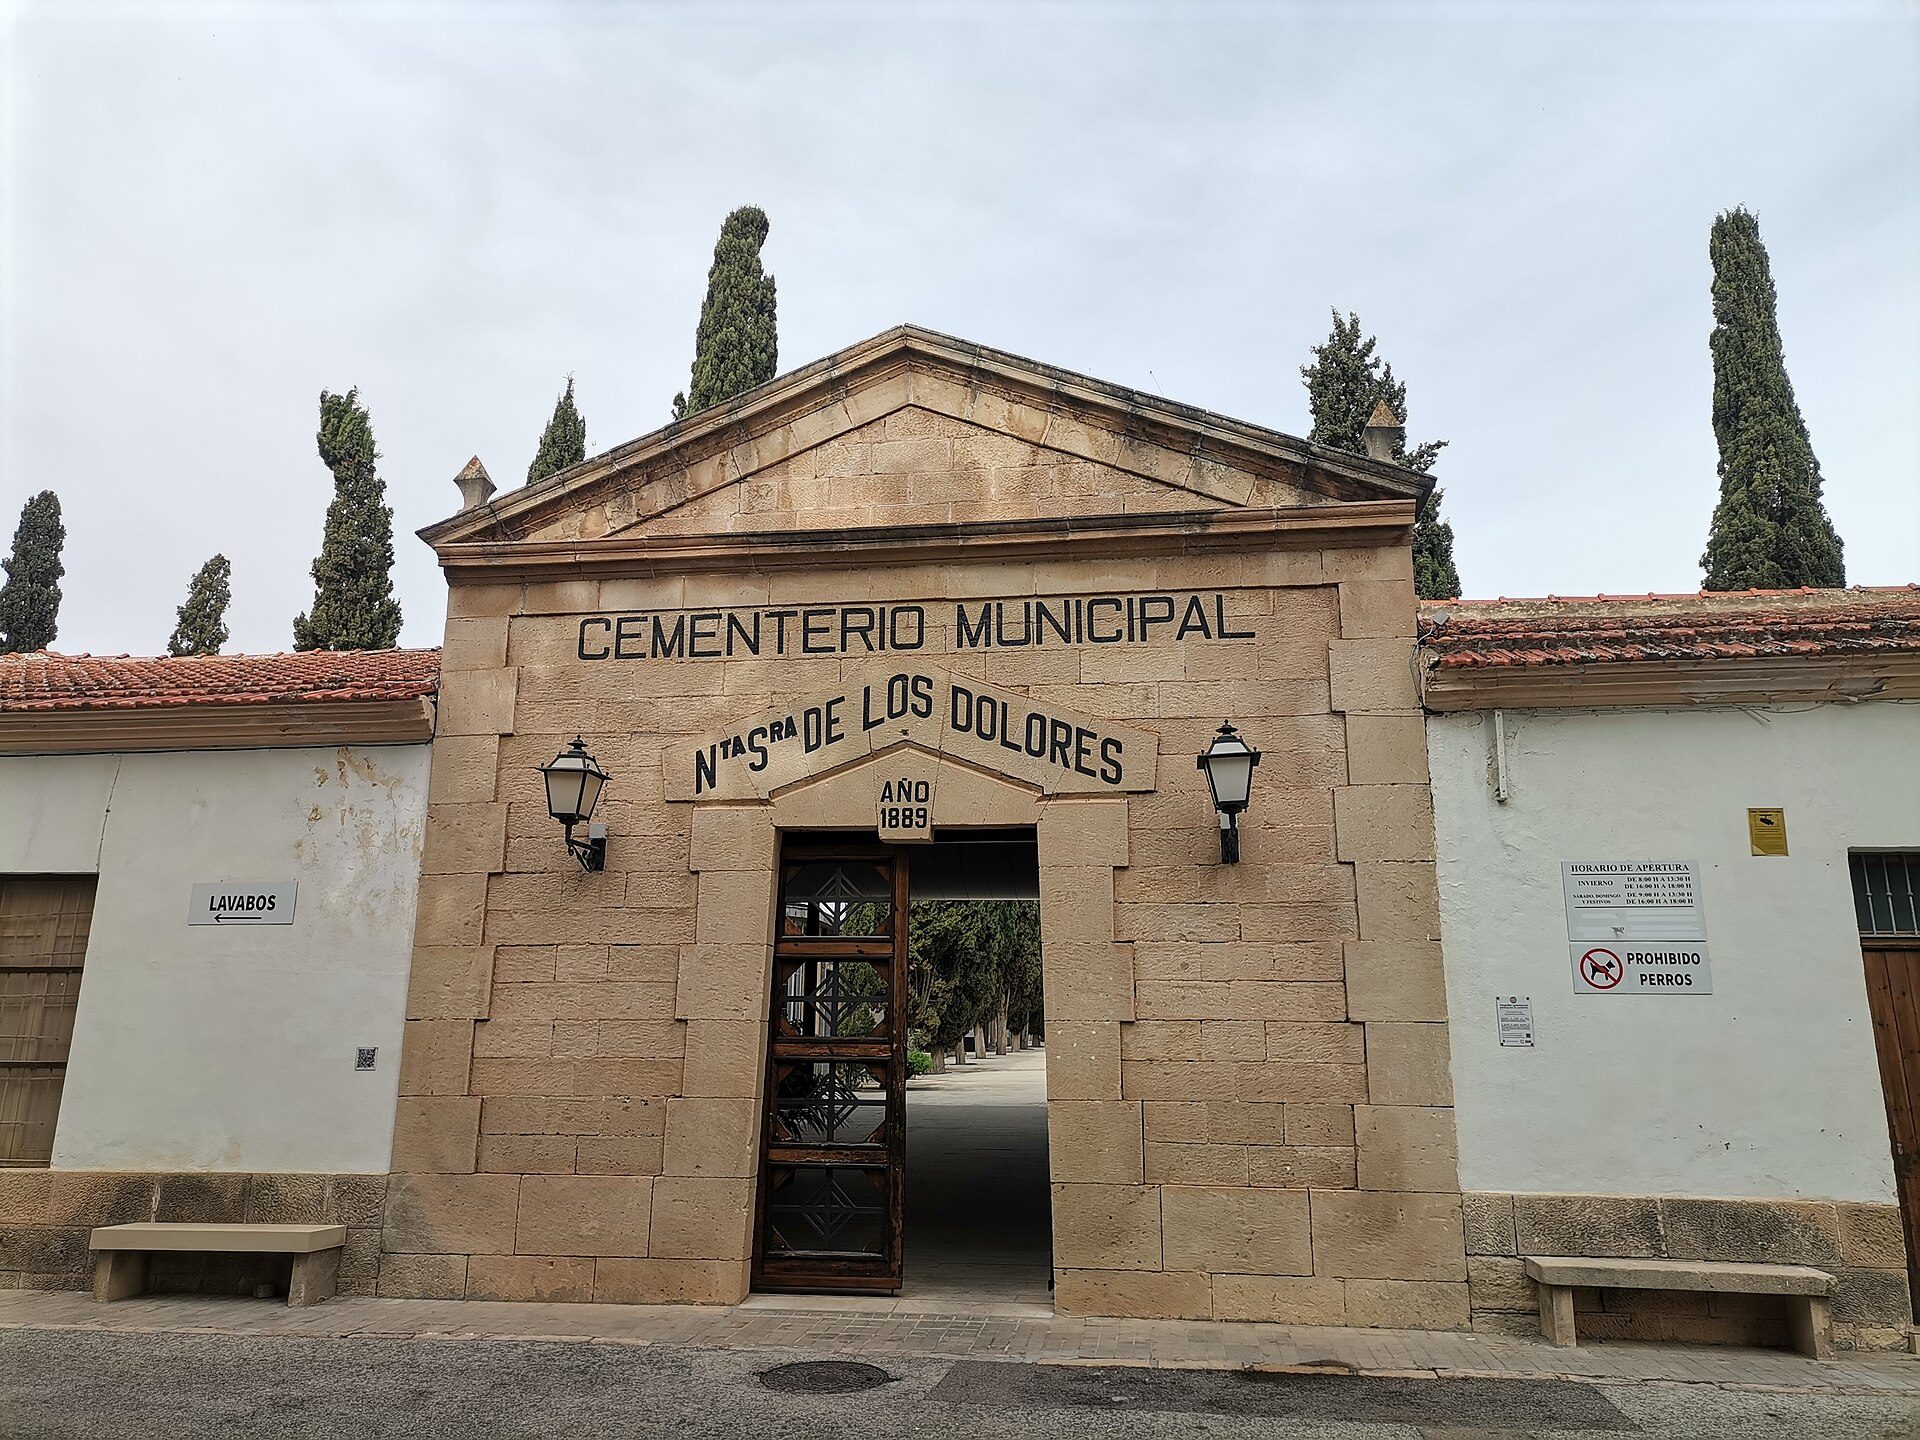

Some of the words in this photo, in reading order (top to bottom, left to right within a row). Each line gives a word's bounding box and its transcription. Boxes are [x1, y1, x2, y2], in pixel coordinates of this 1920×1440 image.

[578, 605, 925, 661] CEMENTERIO
[956, 594, 1256, 649] MUNICIPAL
[803, 695, 846, 755] DE
[862, 673, 934, 732] LOS
[951, 684, 1123, 785] DOLORES
[880, 778, 930, 803] AÑO
[880, 807, 928, 829] 1889
[1571, 864, 1618, 872] HORARIO
[1620, 864, 1634, 872] DE
[1635, 864, 1690, 872] APERTURA
[209, 895, 276, 911] LAVABOS
[1626, 952, 1701, 965] PROHIBIDO
[1640, 973, 1693, 986] PERROS
